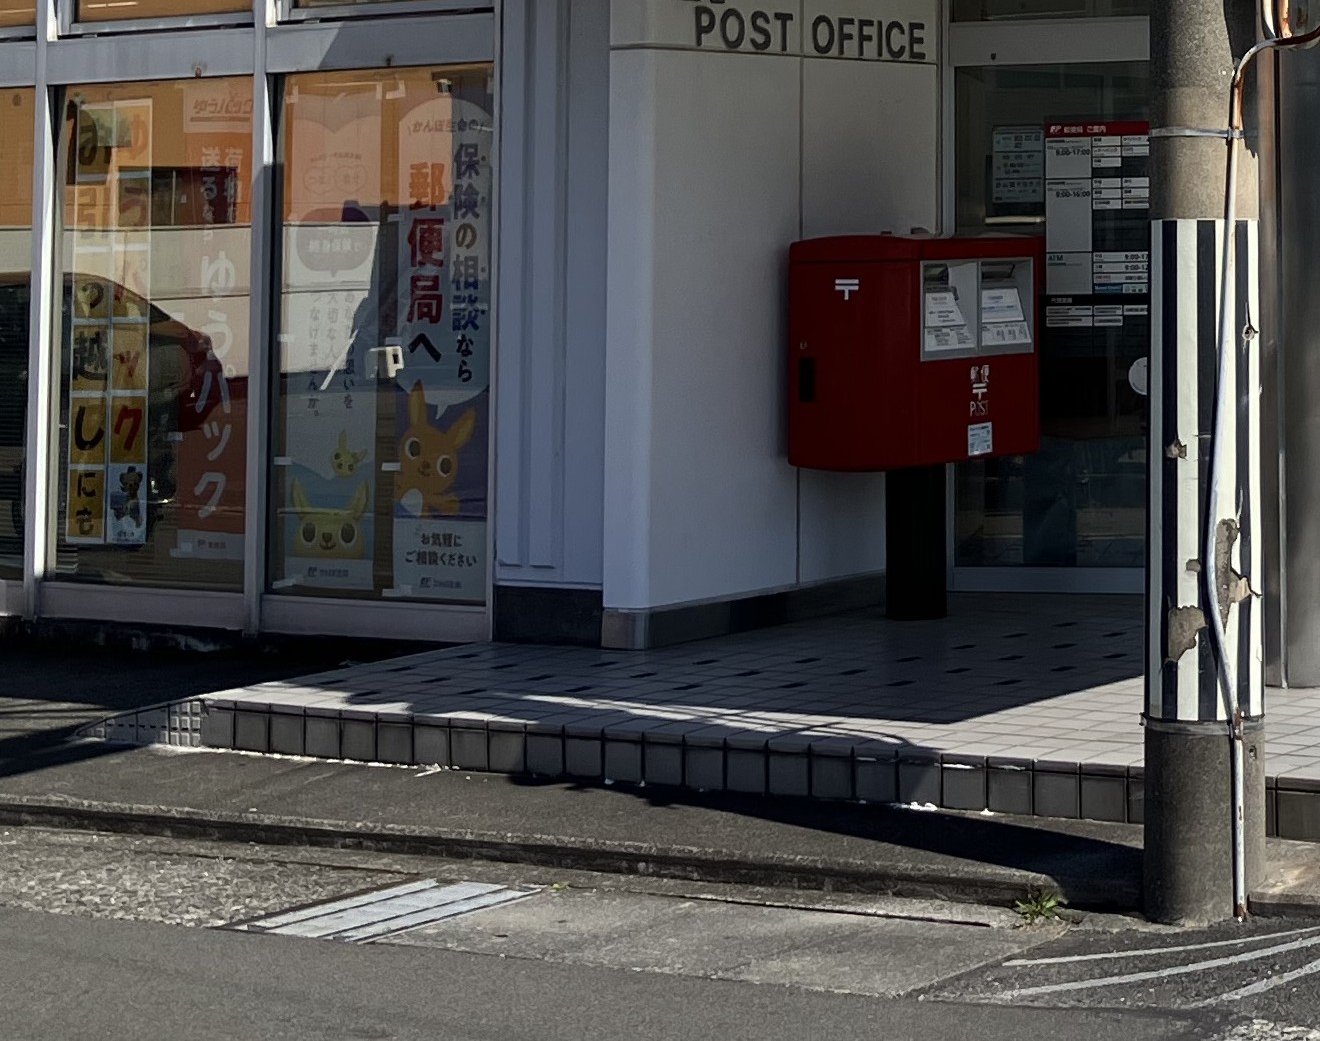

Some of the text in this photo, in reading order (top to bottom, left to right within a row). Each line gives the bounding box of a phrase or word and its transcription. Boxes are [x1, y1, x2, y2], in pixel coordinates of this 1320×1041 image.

[695, 5, 926, 60] POST OFFICE
[407, 162, 446, 363] 郵便局へ
[453, 142, 481, 382] 保険の相談なら
[969, 400, 989, 417] POST
[404, 549, 477, 568] ご相談ください
